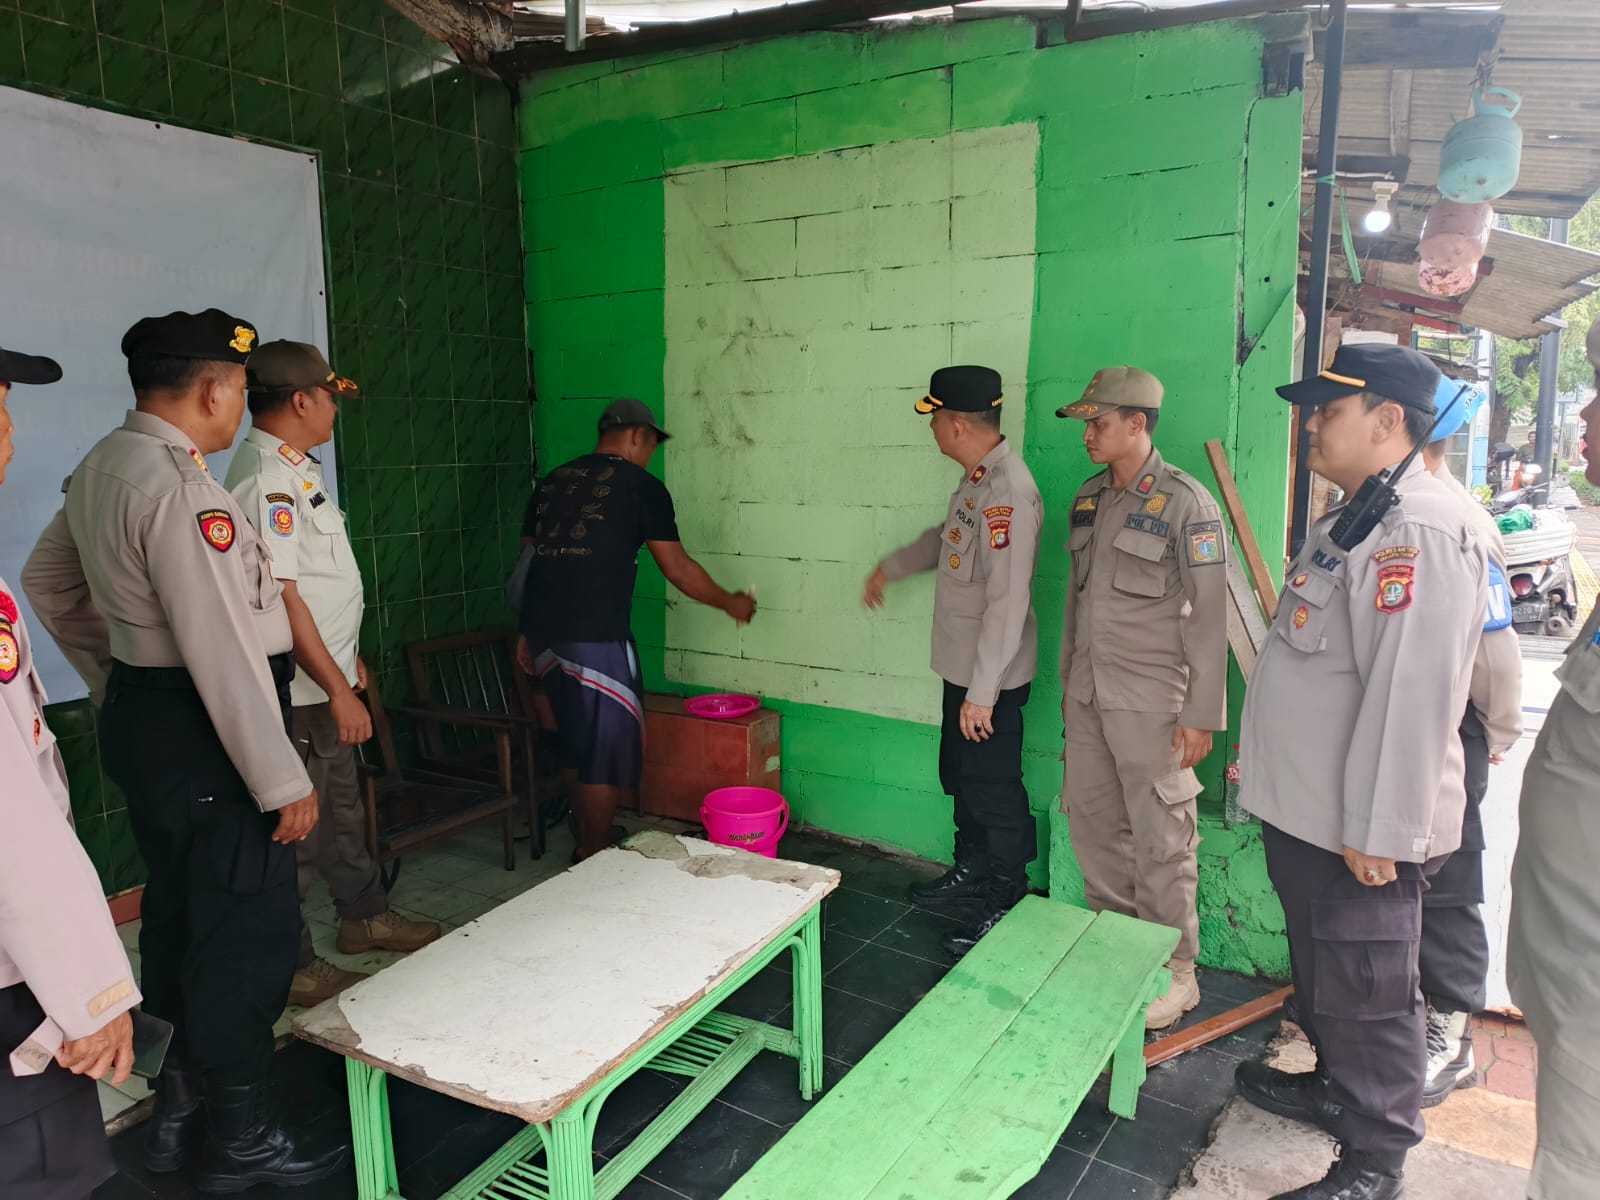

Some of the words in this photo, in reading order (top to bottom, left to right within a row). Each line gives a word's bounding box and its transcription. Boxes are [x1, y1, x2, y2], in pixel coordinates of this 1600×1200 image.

[955, 508, 975, 529] POLRI
[1127, 516, 1145, 529] POL
[1150, 520, 1165, 534] PP
